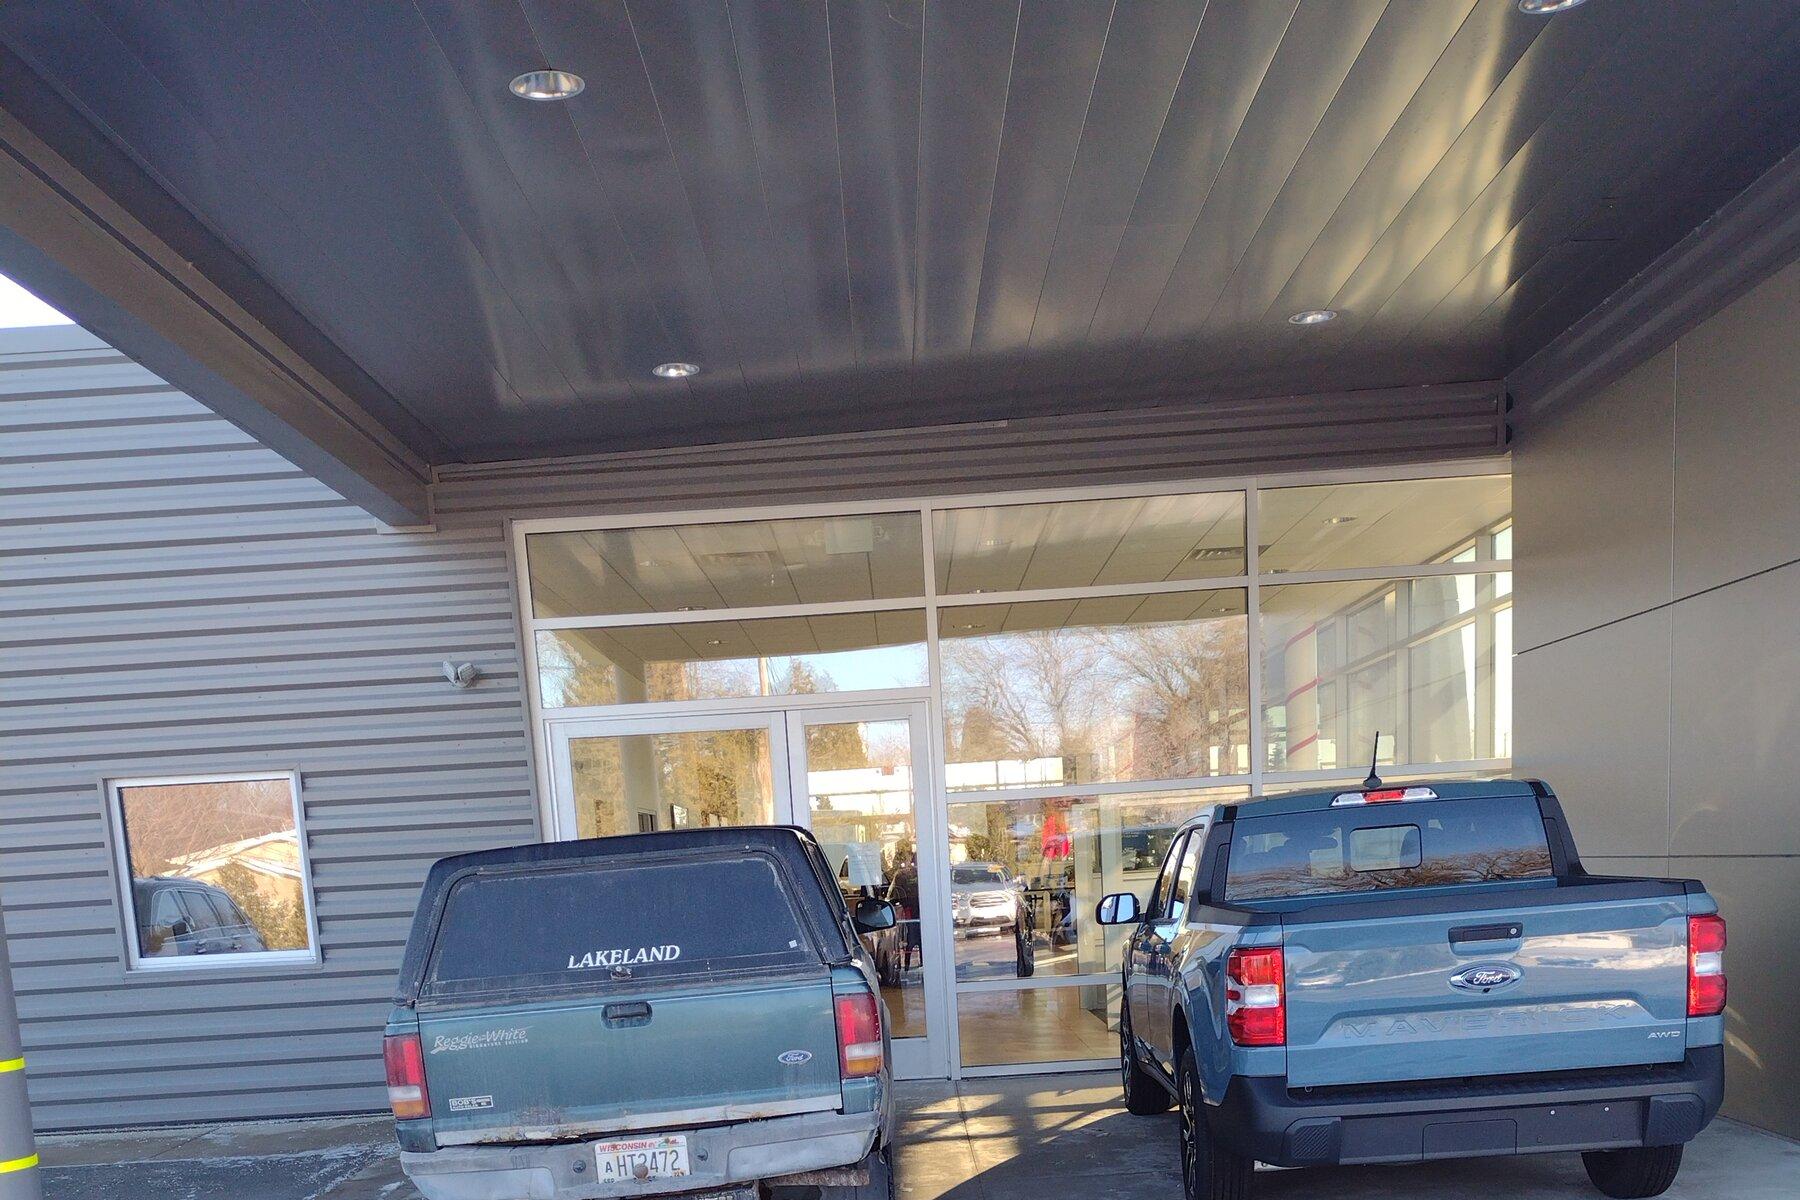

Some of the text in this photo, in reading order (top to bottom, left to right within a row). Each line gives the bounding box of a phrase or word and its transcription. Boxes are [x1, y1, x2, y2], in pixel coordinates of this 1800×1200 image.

[567, 945, 681, 969] LAKELAND
[1344, 1003, 1627, 1040] MAVERICK
[1647, 1030, 1681, 1039] AWD
[600, 1141, 647, 1153] WISCONSIN
